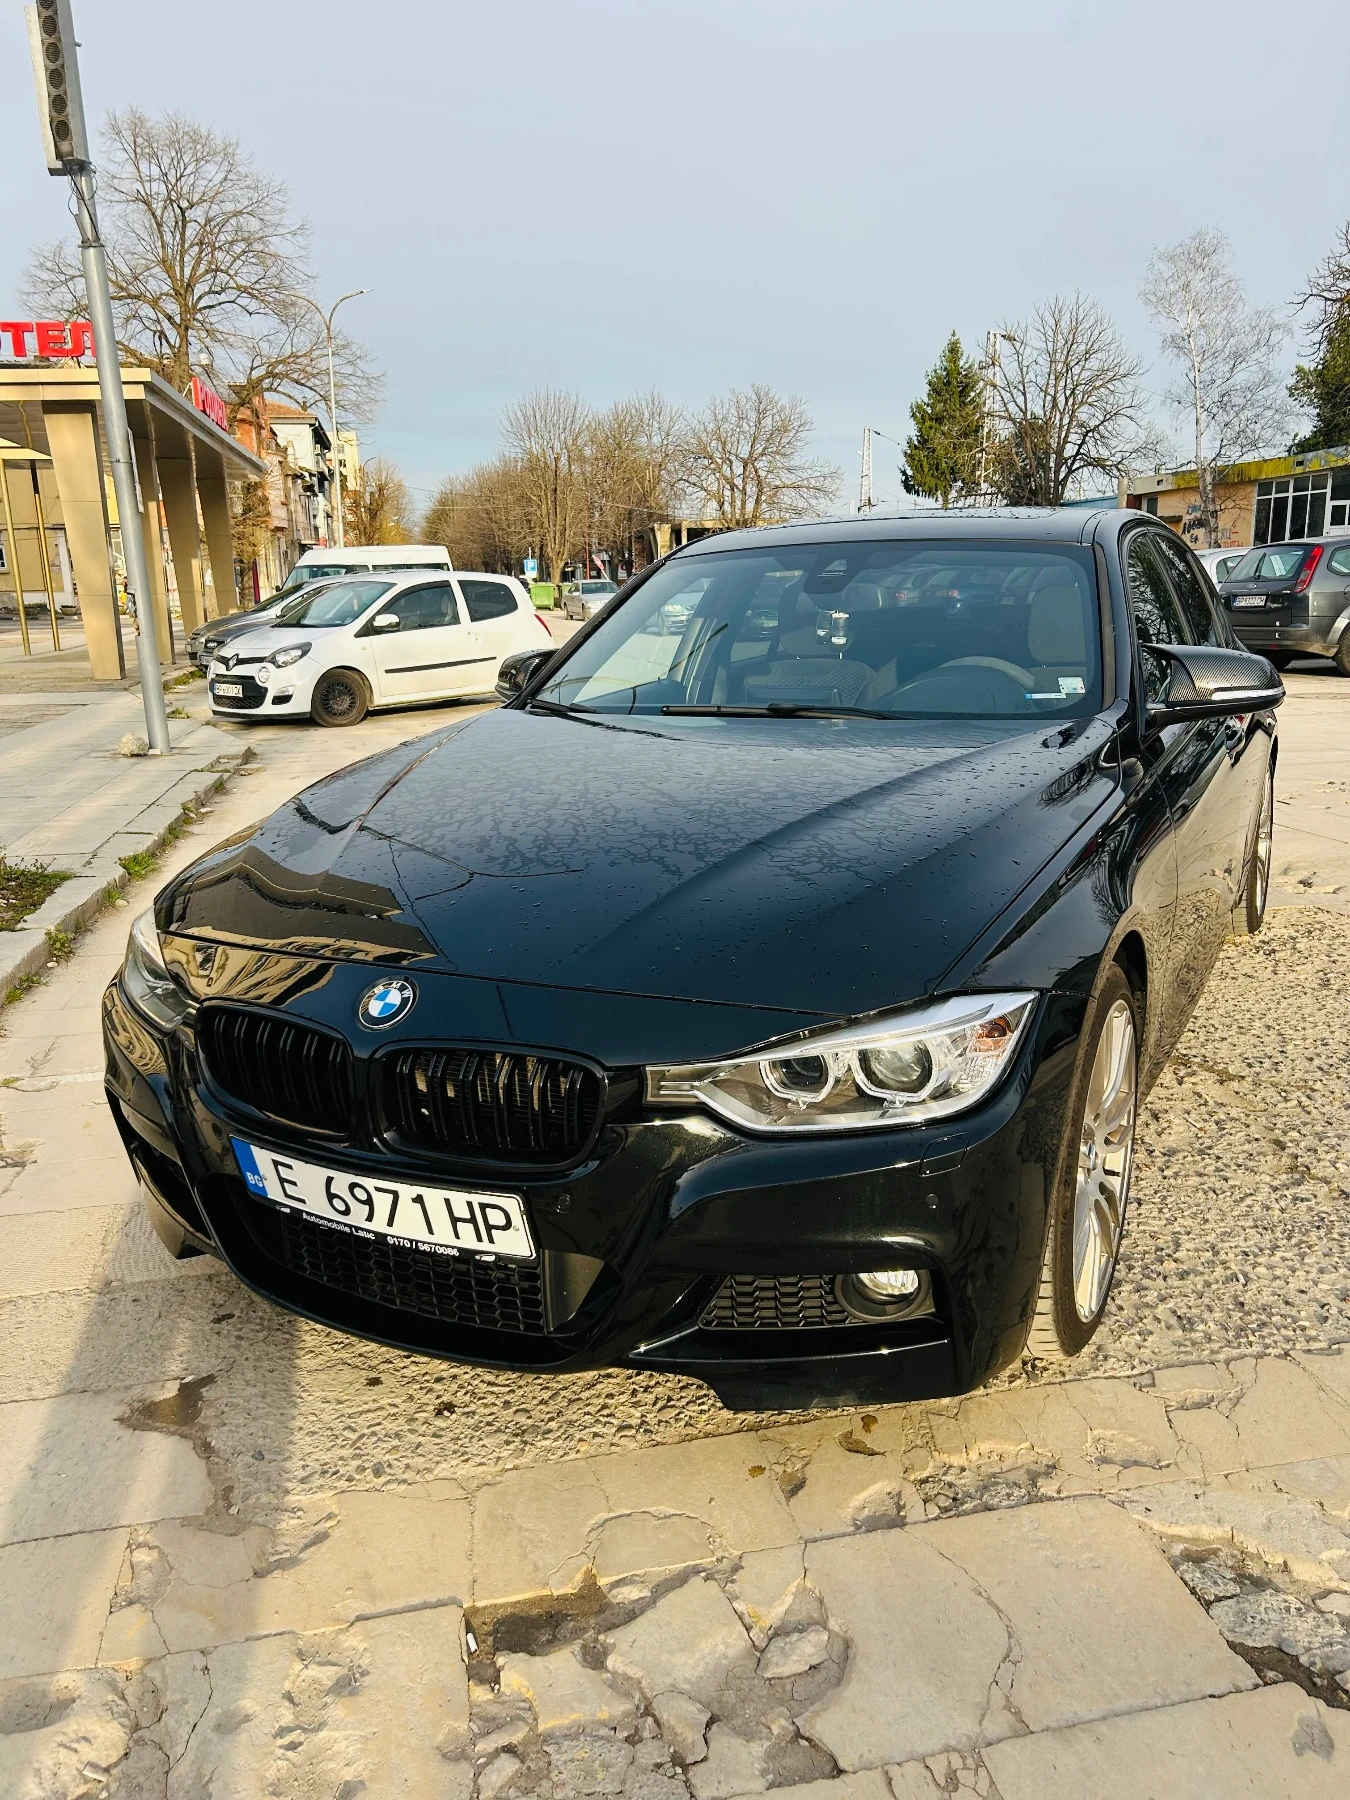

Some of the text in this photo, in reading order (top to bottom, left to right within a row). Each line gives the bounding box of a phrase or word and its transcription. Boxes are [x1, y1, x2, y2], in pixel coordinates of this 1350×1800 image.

[0, 320, 96, 358] ТЕЛ
[374, 981, 412, 998] BMW
[245, 1171, 263, 1188] BG
[270, 1158, 513, 1245] E 6971 HP
[302, 1212, 351, 1233] Automobile
[386, 1235, 411, 1248] 0170
